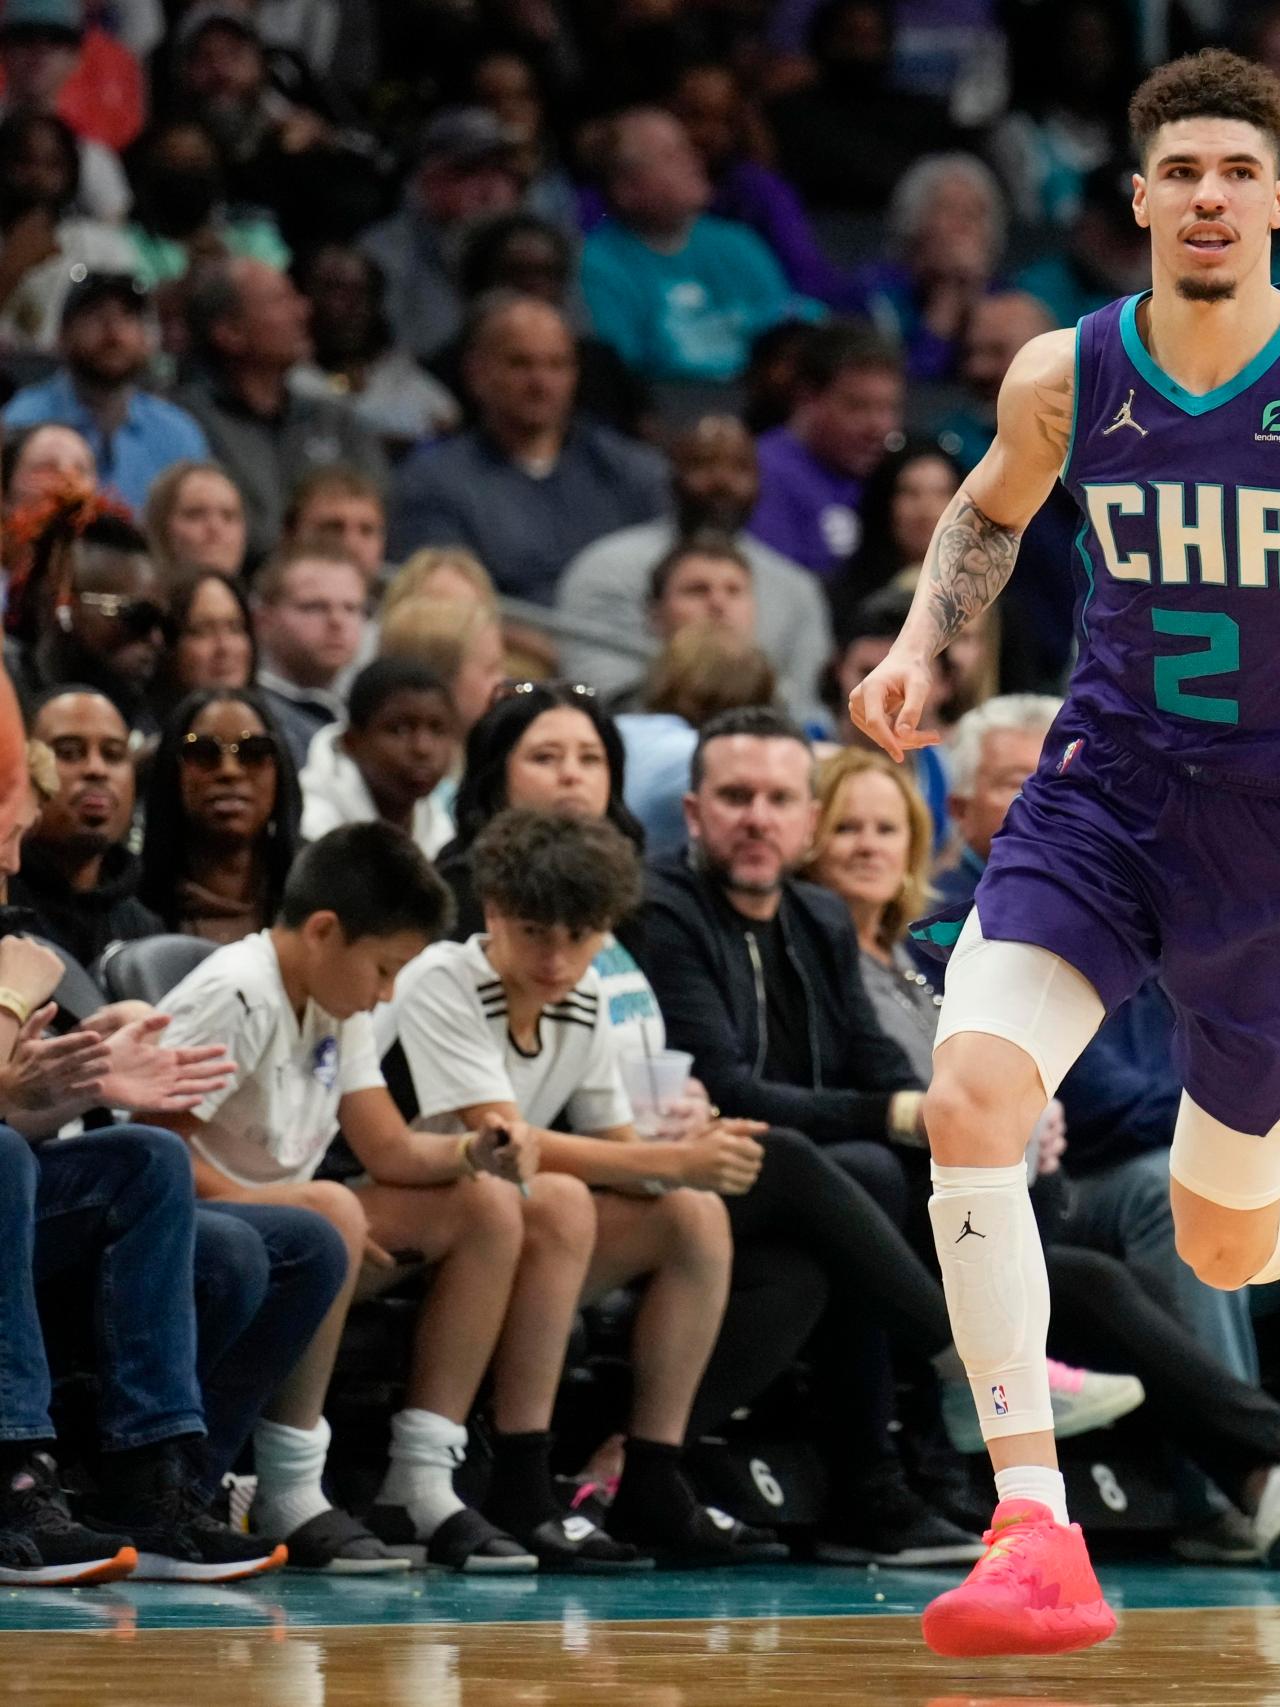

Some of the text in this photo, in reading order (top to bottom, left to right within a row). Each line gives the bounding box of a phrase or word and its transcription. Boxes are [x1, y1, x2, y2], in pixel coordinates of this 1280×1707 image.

[1151, 607, 1240, 725] 2
[749, 1458, 785, 1507] 6
[1090, 1463, 1128, 1511] 8
